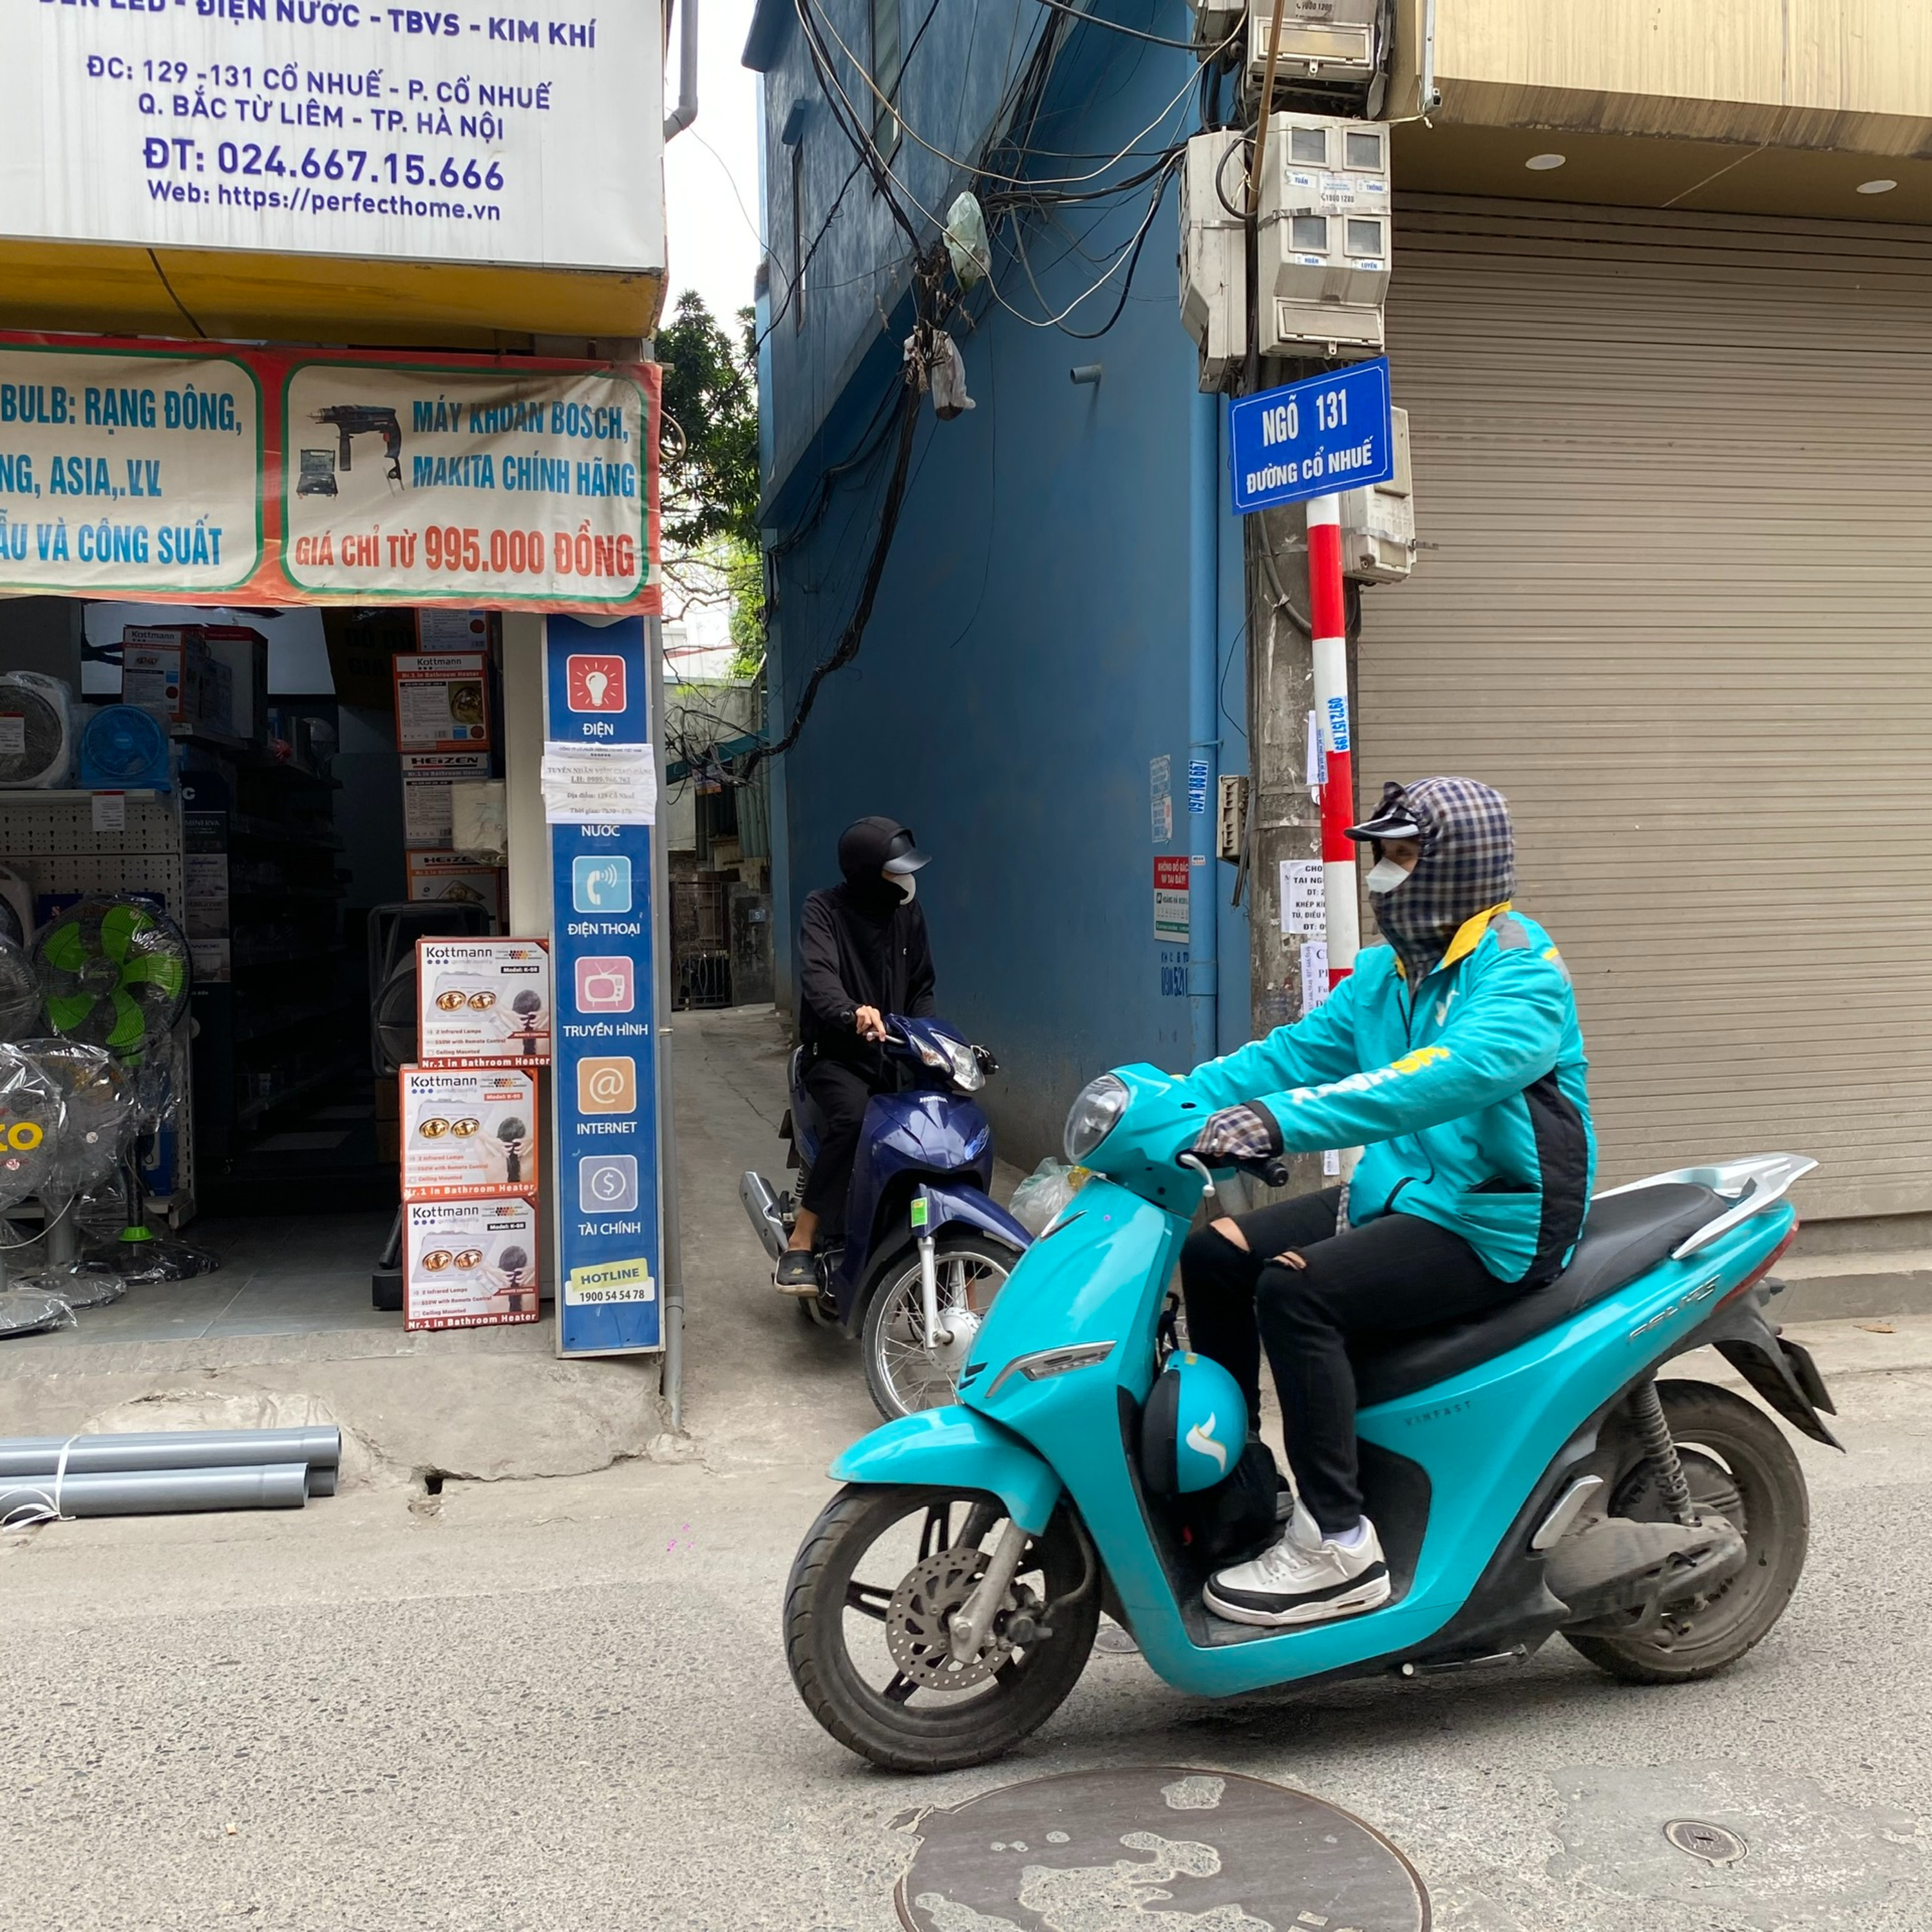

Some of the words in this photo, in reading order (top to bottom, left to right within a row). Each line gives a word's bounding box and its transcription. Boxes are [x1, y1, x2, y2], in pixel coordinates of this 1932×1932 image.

[388, 9, 459, 36] TBVS
[489, 17, 538, 43] KIM
[549, 19, 596, 48] KHÍ
[87, 55, 133, 79] ĐC:
[144, 60, 188, 82] 129
[263, 62, 298, 91] CỔ
[307, 69, 383, 98] NHUẾ
[409, 80, 428, 101] P.
[437, 75, 471, 104] CỔ
[478, 82, 553, 110] NHUẾ
[138, 93, 162, 115] Q.
[173, 85, 227, 118] BẮC
[235, 94, 272, 122] TỪ
[281, 98, 343, 128] LIÊM
[371, 109, 407, 132] TP.
[417, 107, 453, 136] HÀ
[460, 111, 503, 144] NỘI
[142, 137, 204, 172] ĐT:
[218, 142, 504, 191] 024.667.15.666
[147, 179, 209, 204] Web:
[218, 184, 500, 221] https://perfecthome.vn
[1, 384, 75, 424] BULB:
[85, 388, 156, 435] RẠNG
[164, 383, 242, 435] ĐÔNG,
[413, 395, 462, 432] MÁY
[469, 401, 544, 434] KHOAN
[551, 401, 628, 444] BOSCH,
[1262, 393, 1299, 448] NGÕ
[1316, 388, 1347, 431] 131
[413, 454, 495, 489] MAKITA
[502, 450, 570, 494] CHÍNH
[577, 457, 635, 497] HÃNG
[1246, 462, 1298, 495] ĐƯỜNG
[1302, 446, 1324, 480] CỔ
[1328, 435, 1374, 474] NHUẾ
[37, 517, 70, 561] VÀ
[79, 518, 149, 564] CÔNG
[158, 514, 222, 565] SUẤT
[296, 530, 334, 565] GIÁ
[341, 524, 380, 567] CHỈ
[386, 529, 417, 568] TỪ
[425, 525, 545, 574] 995.000
[554, 518, 634, 576] ĐỒNG
[131, 630, 175, 640] Kottmann
[583, 721, 614, 738] ĐIỆN
[567, 922, 598, 938] ĐIỆN
[600, 923, 640, 937] THOẠI
[426, 947, 492, 958] Kottmann
[563, 1022, 613, 1037] TRUYỀN
[616, 1022, 649, 1036] HÌNH
[422, 1059, 444, 1068] Nr.1
[448, 1058, 458, 1067] in
[462, 1057, 512, 1066] Bathroom
[515, 1057, 551, 1066] Heater
[411, 1076, 477, 1087] Kottmann
[577, 1122, 638, 1135] INTERNET
[444, 1186, 495, 1195] Bathroom
[413, 1207, 479, 1218] Kottmann
[578, 1222, 598, 1236] TÀI
[600, 1220, 641, 1235] CHÍNH
[581, 1268, 640, 1285] HOTLINE
[580, 1292, 603, 1302] 1900
[605, 1291, 617, 1301] 54
[619, 1291, 631, 1300] 54
[633, 1289, 645, 1300] 78
[408, 1321, 430, 1329] Nr.1
[448, 1316, 498, 1326] Bathroom
[501, 1313, 536, 1322] Heater
[1404, 1401, 1471, 1426] VINFAST
